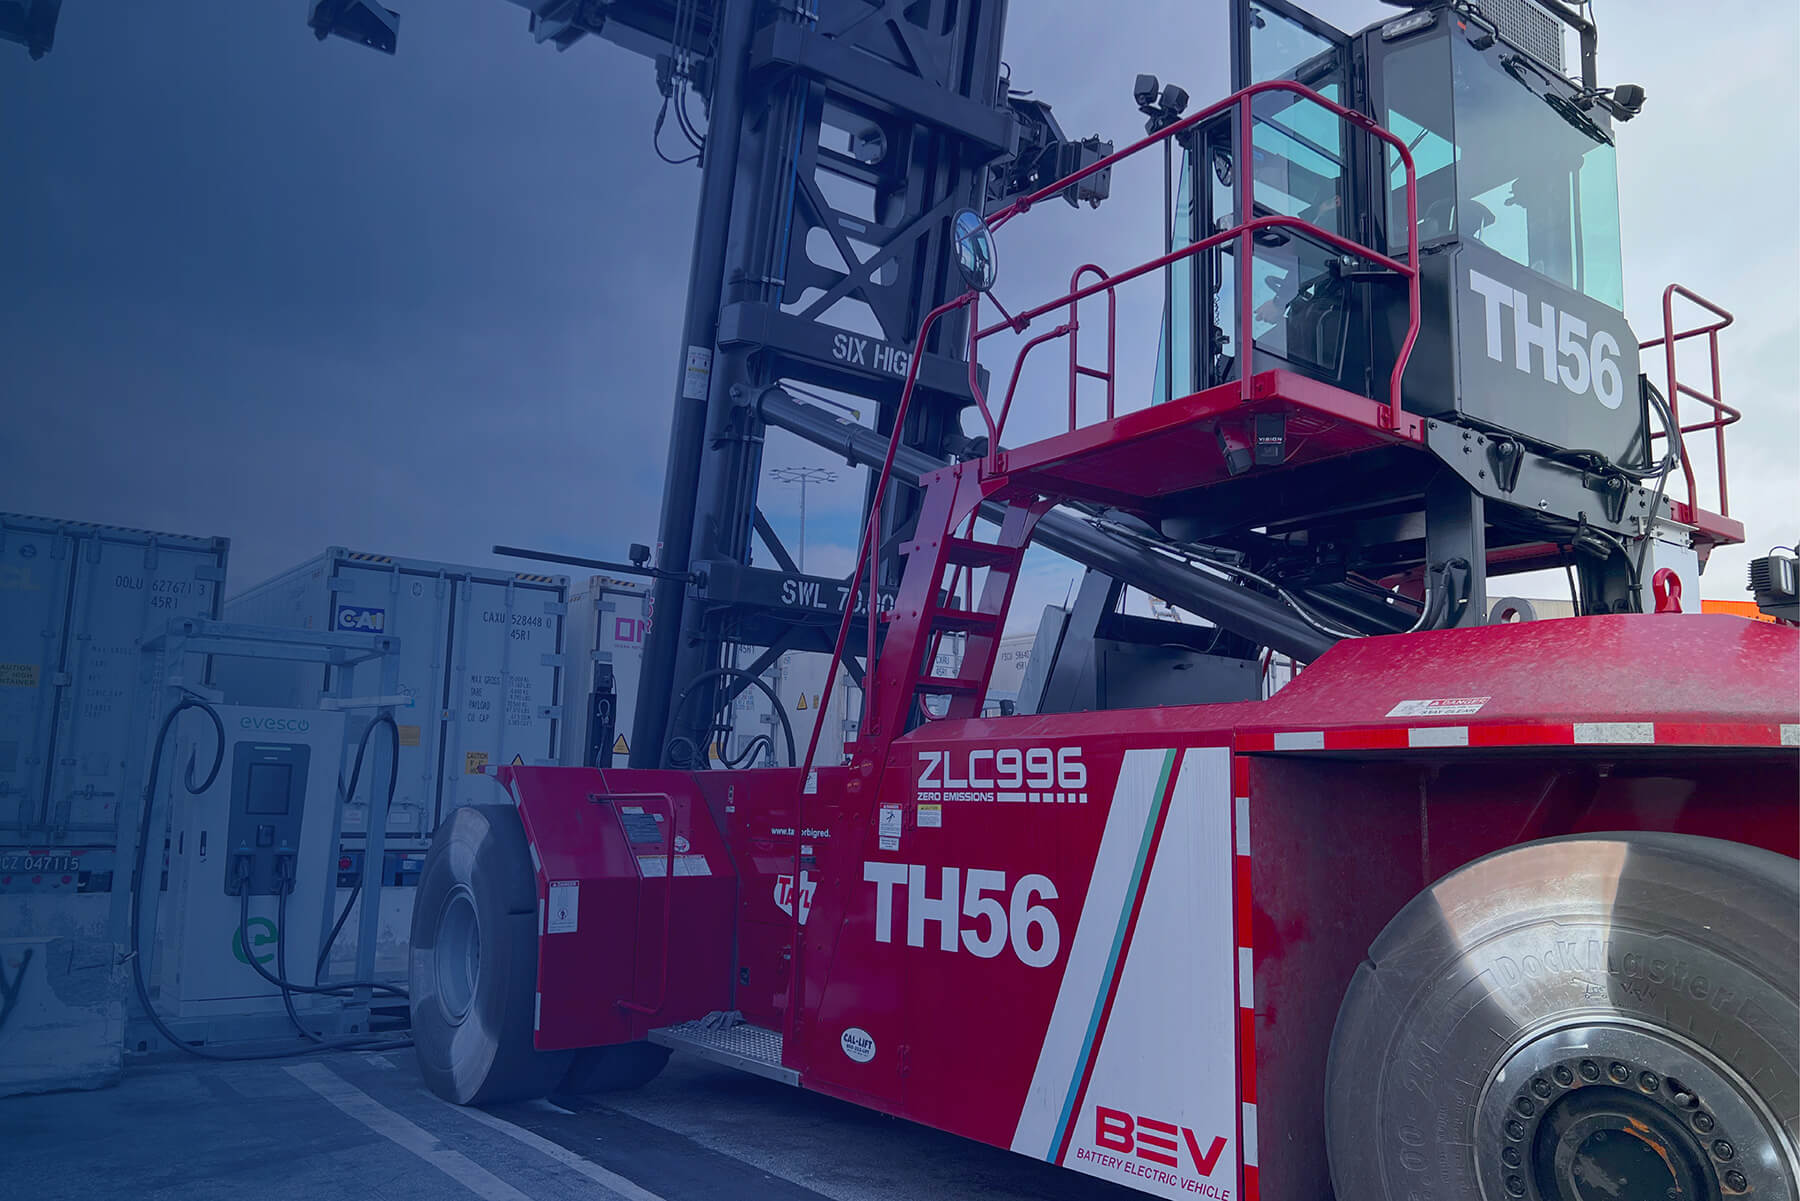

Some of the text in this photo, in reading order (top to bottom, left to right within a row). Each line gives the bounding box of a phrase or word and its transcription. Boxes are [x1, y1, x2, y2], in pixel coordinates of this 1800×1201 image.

[832, 333, 867, 365] SIX
[1470, 268, 1624, 410] TH56
[151, 577, 193, 595] 627671
[781, 579, 828, 609] SWL
[150, 596, 180, 610] 45R1
[338, 608, 385, 631] CAI
[482, 611, 506, 624] CAXU
[511, 614, 543, 628] 528448
[510, 630, 531, 641] 45R1
[917, 746, 1087, 789] ZLC996
[917, 791, 994, 802] ZERO EMISSIONS
[24, 856, 79, 871] 047115
[863, 861, 1060, 968] TH56
[1096, 1105, 1228, 1178] BEV
[1077, 1147, 1231, 1201] BATTERY ELECTRIC VEHICLE
